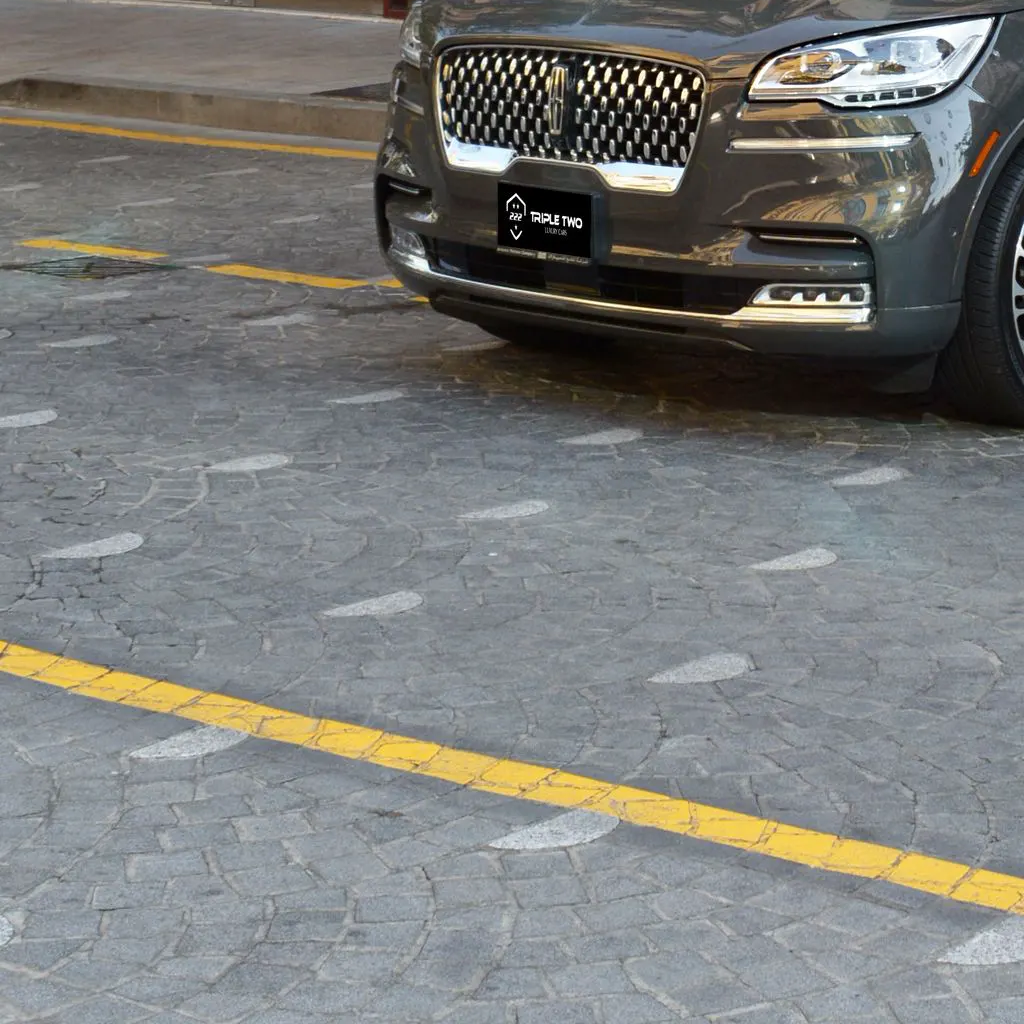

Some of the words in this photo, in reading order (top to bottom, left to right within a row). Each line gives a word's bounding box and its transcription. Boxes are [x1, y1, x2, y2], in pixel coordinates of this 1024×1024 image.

[509, 212, 523, 222] 222
[530, 211, 560, 226] TRIPLE
[561, 215, 583, 229] TWO
